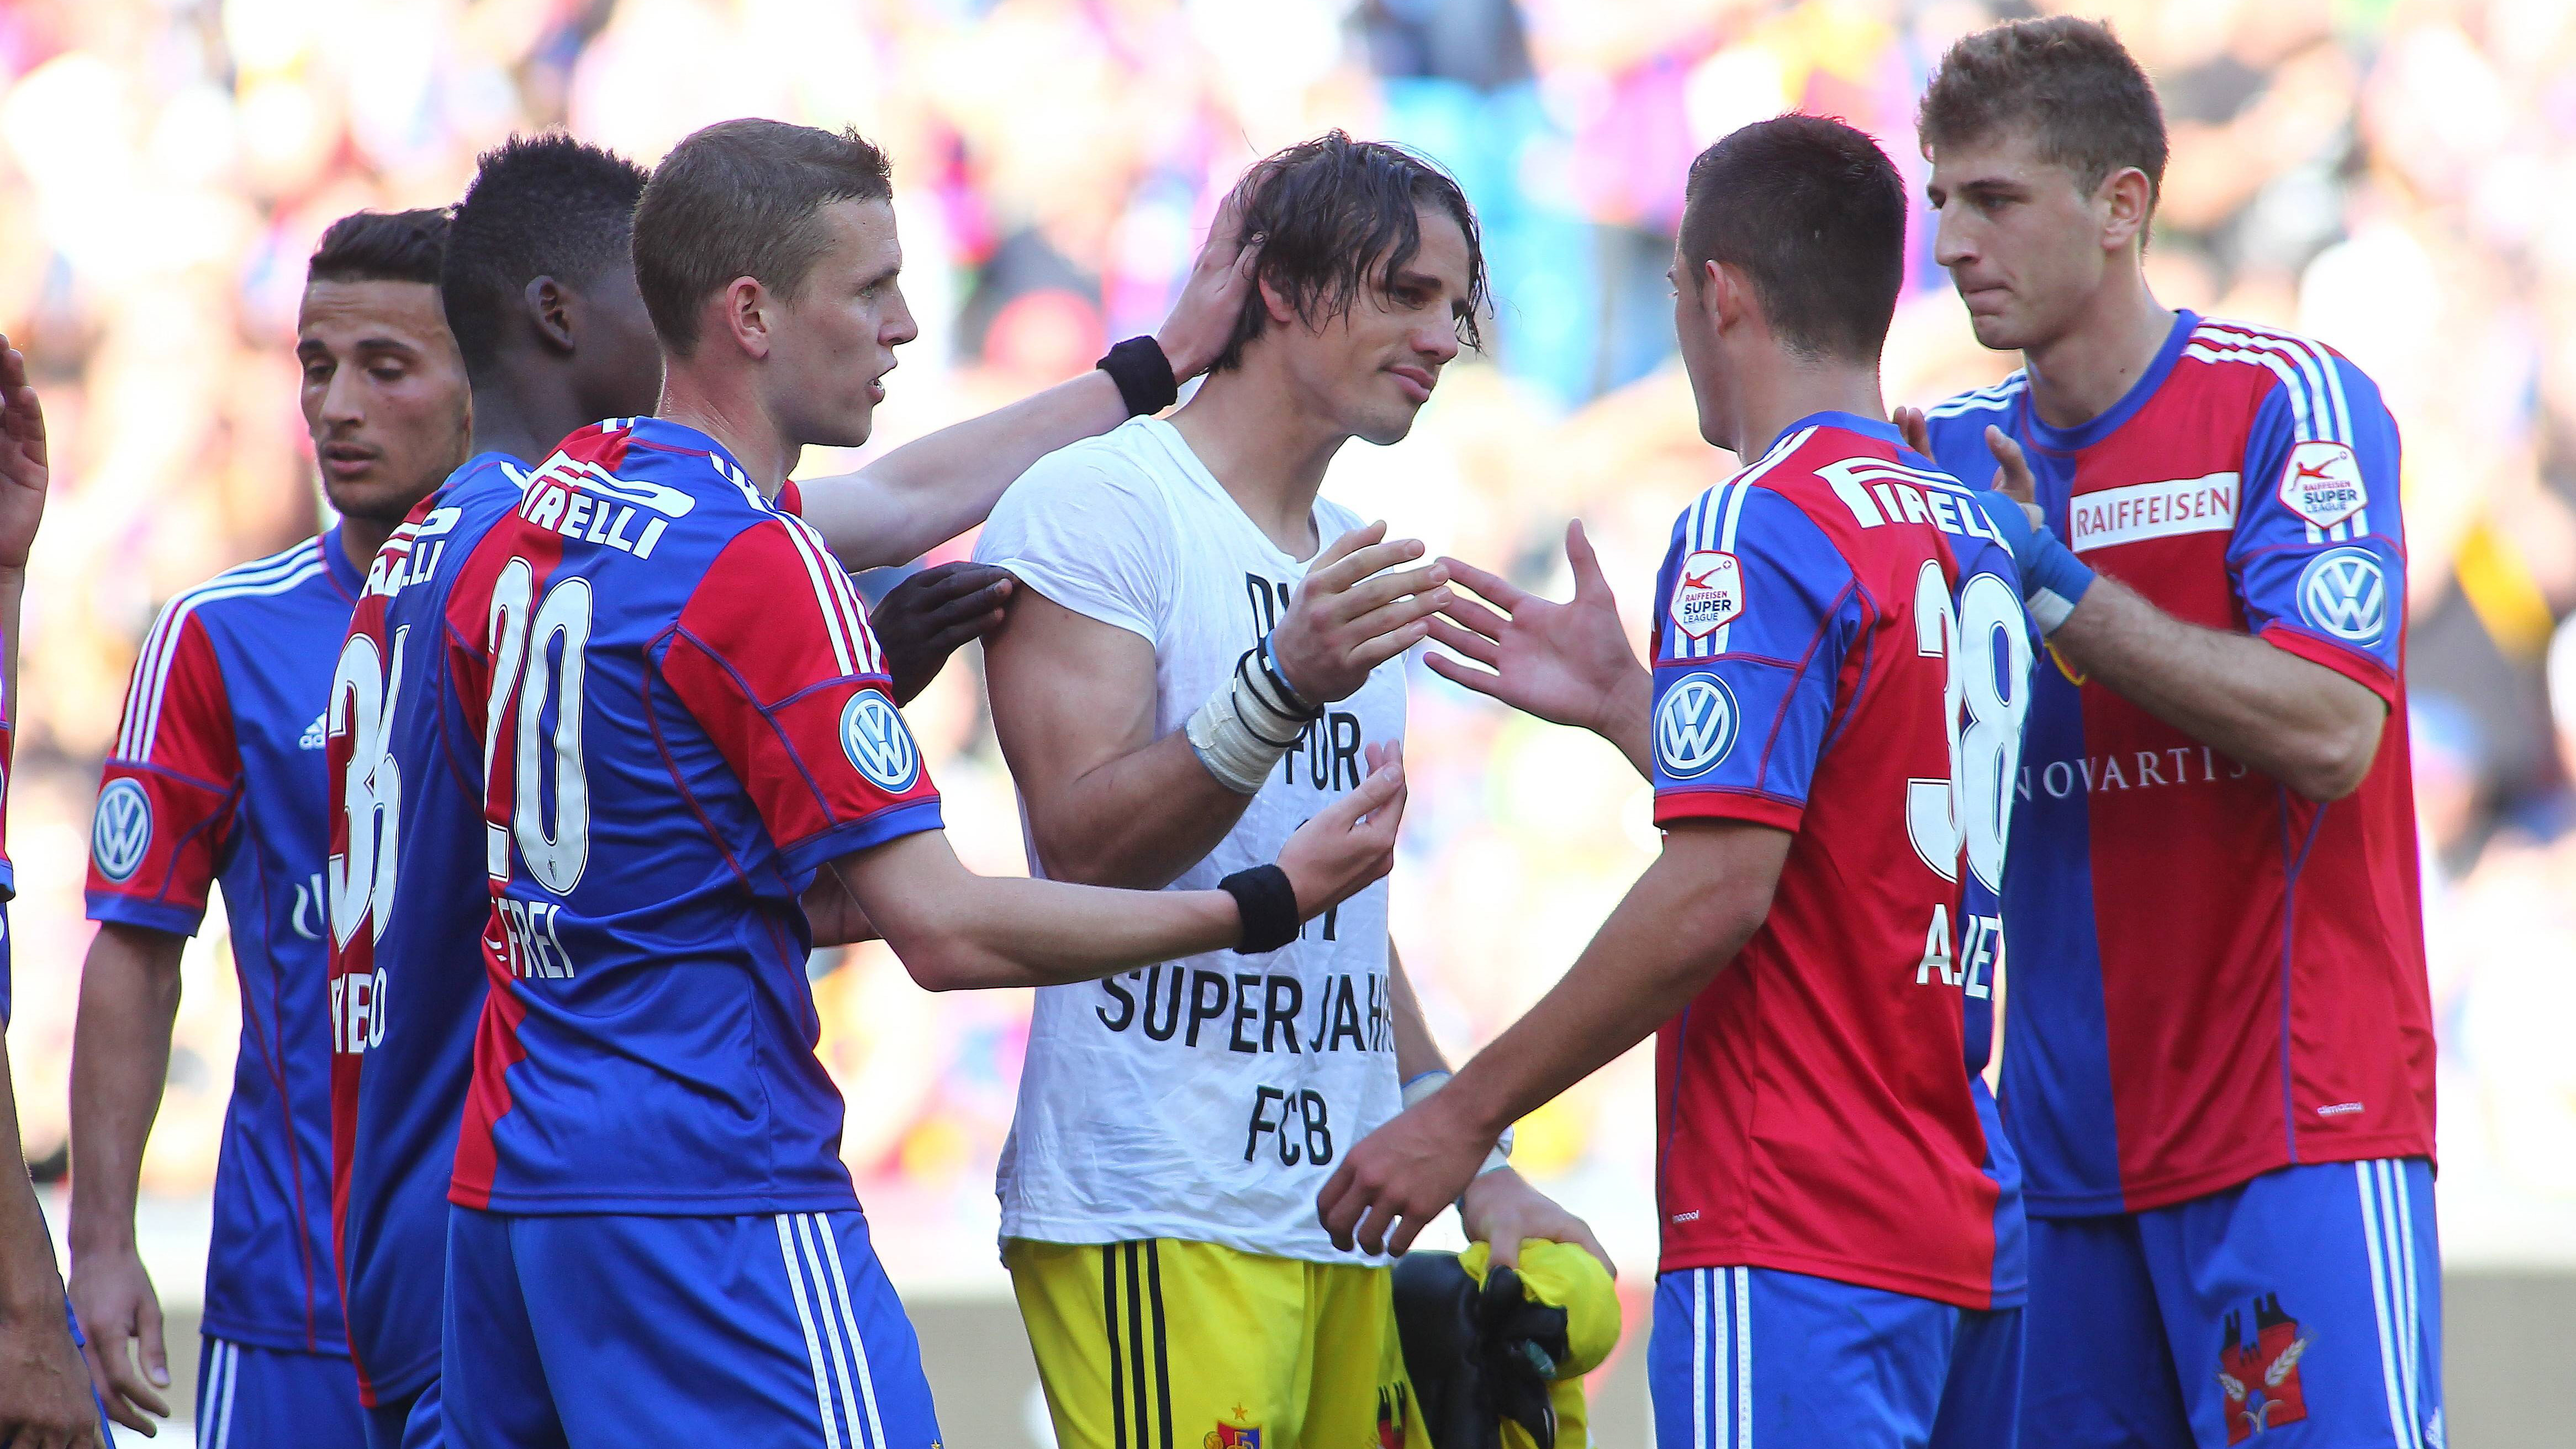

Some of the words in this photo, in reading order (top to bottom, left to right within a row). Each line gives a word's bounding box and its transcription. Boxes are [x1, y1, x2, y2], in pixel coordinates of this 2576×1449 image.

[2076, 487, 2230, 538] RAIFFEISEN
[2305, 488, 2357, 504] SUPER
[2306, 501, 2347, 513] LEAGUE
[1683, 599, 1732, 614] SUPER
[1683, 613, 1719, 624] LEAGUE
[1685, 591, 1728, 602] RAIFFEISEN
[484, 556, 591, 896] 20
[1906, 558, 2033, 897] 38
[2015, 746, 2246, 803] NOVARTI
[1095, 966, 1301, 1053] SUPER
[1244, 1084, 1333, 1166] FCB
